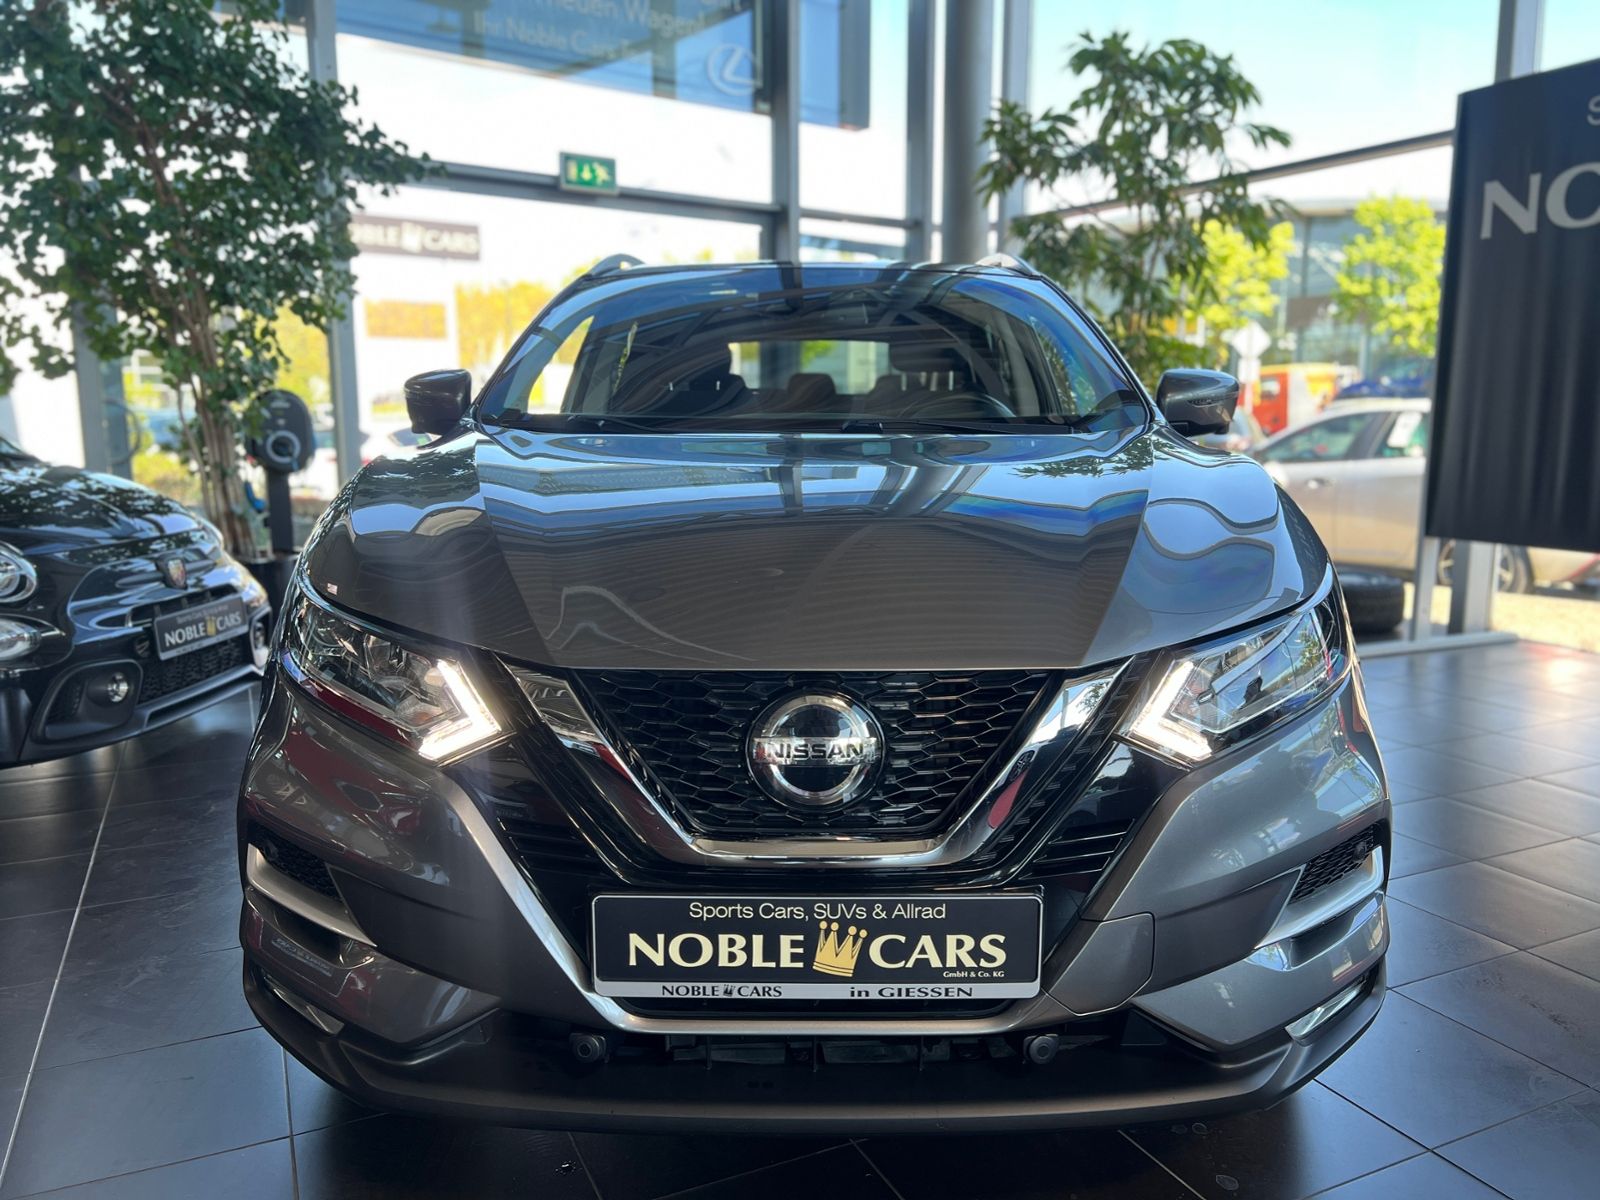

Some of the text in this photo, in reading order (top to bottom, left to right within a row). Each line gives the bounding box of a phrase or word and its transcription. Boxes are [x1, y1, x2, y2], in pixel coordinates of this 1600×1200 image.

[505, 16, 567, 50] Noble
[423, 229, 479, 254] CARS
[164, 621, 206, 648] NOBLE
[216, 611, 242, 632] CARS
[766, 743, 865, 759] NISSAN
[689, 902, 946, 921] Sports Cars, SUVs & Allrad
[628, 932, 1007, 968] NOBLE CARS
[943, 970, 1005, 978] GmbH & Co. KG
[661, 984, 973, 998] NOBLE CARS in GIESSEN
